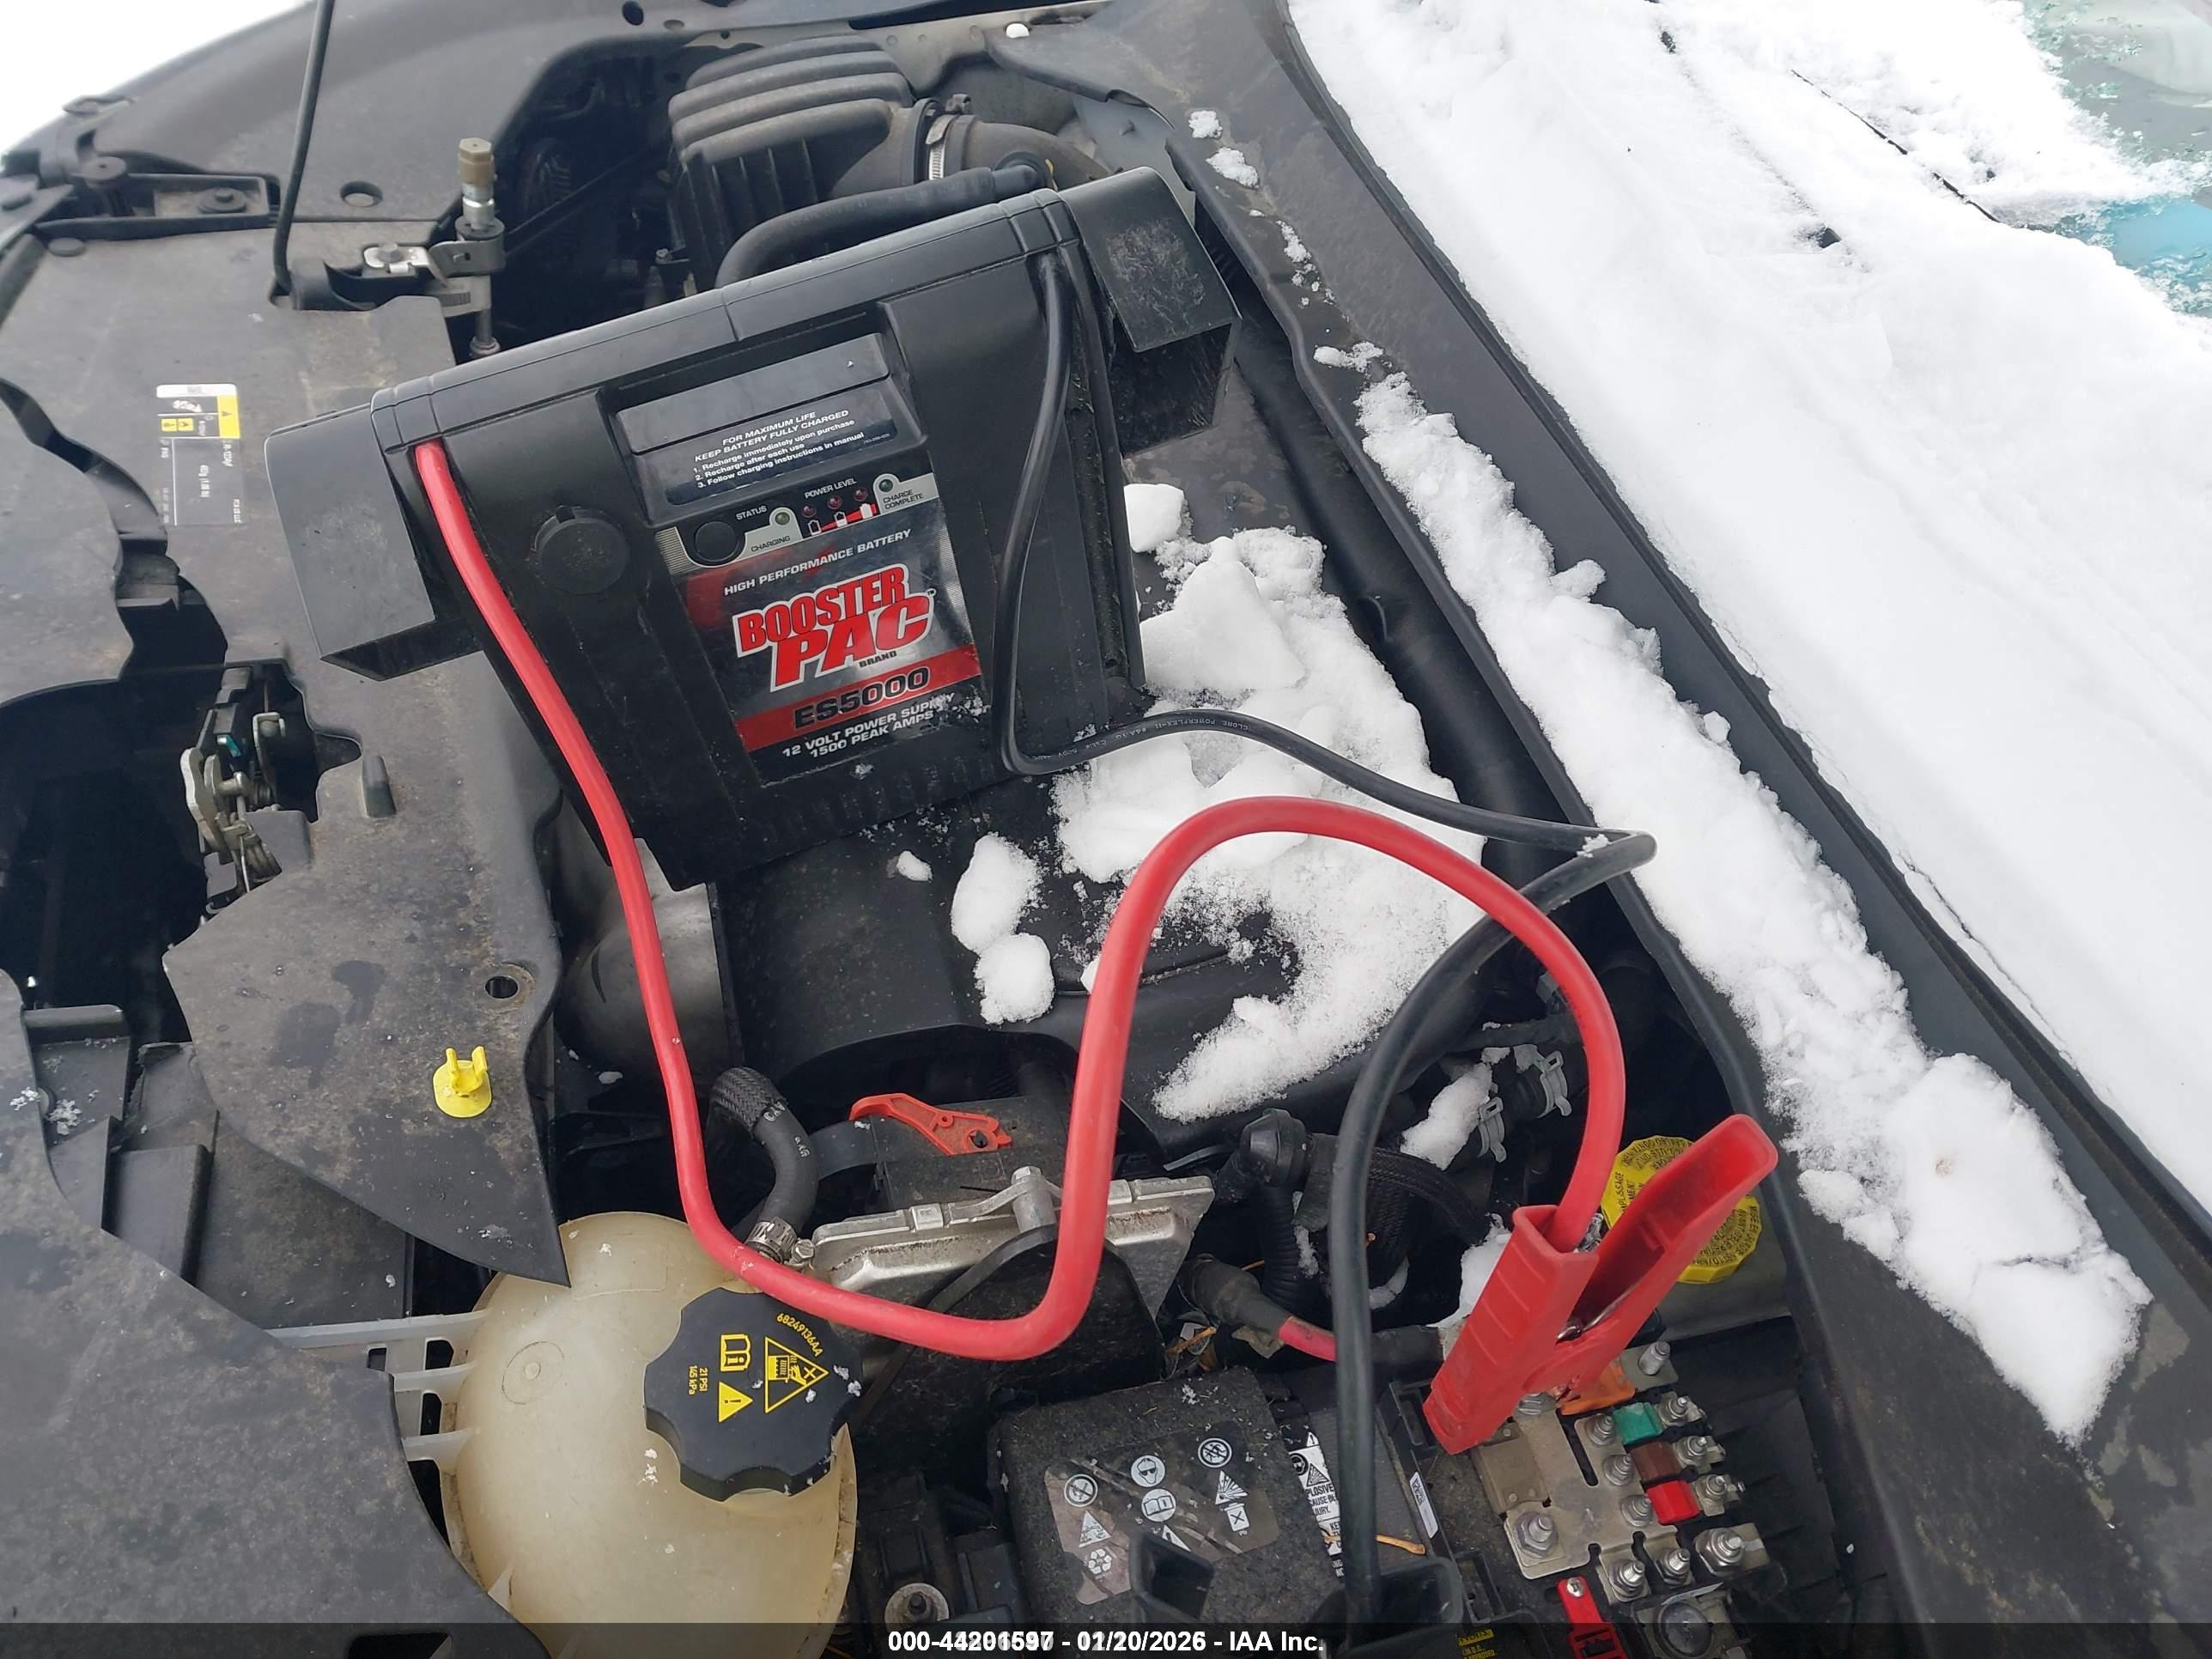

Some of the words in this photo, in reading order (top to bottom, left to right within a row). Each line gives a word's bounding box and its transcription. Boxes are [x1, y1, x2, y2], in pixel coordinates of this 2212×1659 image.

[695, 449, 721, 462] KEEP
[723, 434, 767, 453] BATTERY
[769, 426, 799, 440] FULLY
[800, 410, 849, 429] CHARGED
[702, 453, 742, 471] Recharge
[744, 437, 793, 459] immediately
[794, 432, 816, 446] upon
[817, 420, 854, 437] purchase
[722, 435, 744, 446] FOR
[744, 418, 793, 440] MAXIMUM
[795, 411, 816, 424] LIFE
[705, 462, 745, 478] Recharge
[746, 455, 767, 465] after
[768, 449, 788, 459] each
[789, 443, 805, 453] use
[708, 471, 735, 486] Follow
[737, 461, 774, 477] charging
[775, 446, 823, 465] instructions
[834, 432, 864, 447] manual
[804, 484, 834, 499] POWER
[834, 477, 857, 490] LEVEL
[883, 489, 913, 503] CHARGE
[884, 493, 924, 510] COMPLETE
[736, 505, 767, 520] STATUS
[750, 535, 791, 552] CHARGING
[724, 578, 756, 596] HIGH
[759, 547, 854, 586] PERFORMANCE
[857, 529, 912, 553] BATTERY
[733, 563, 908, 657] BOOSTER
[771, 594, 934, 692] PAC
[859, 649, 897, 668] BRAND
[794, 667, 930, 730] ES5000
[782, 744, 801, 757] 12
[805, 732, 840, 750] VOLT
[844, 712, 897, 738] POWER
[811, 739, 847, 758] 1500
[851, 726, 889, 746] PEAK
[892, 710, 934, 732] AMPS
[776, 1312, 823, 1357] 68249136AA
[688, 1378, 697, 1395] kPa
[699, 1367, 708, 1376] 21
[699, 1377, 708, 1392] PSI
